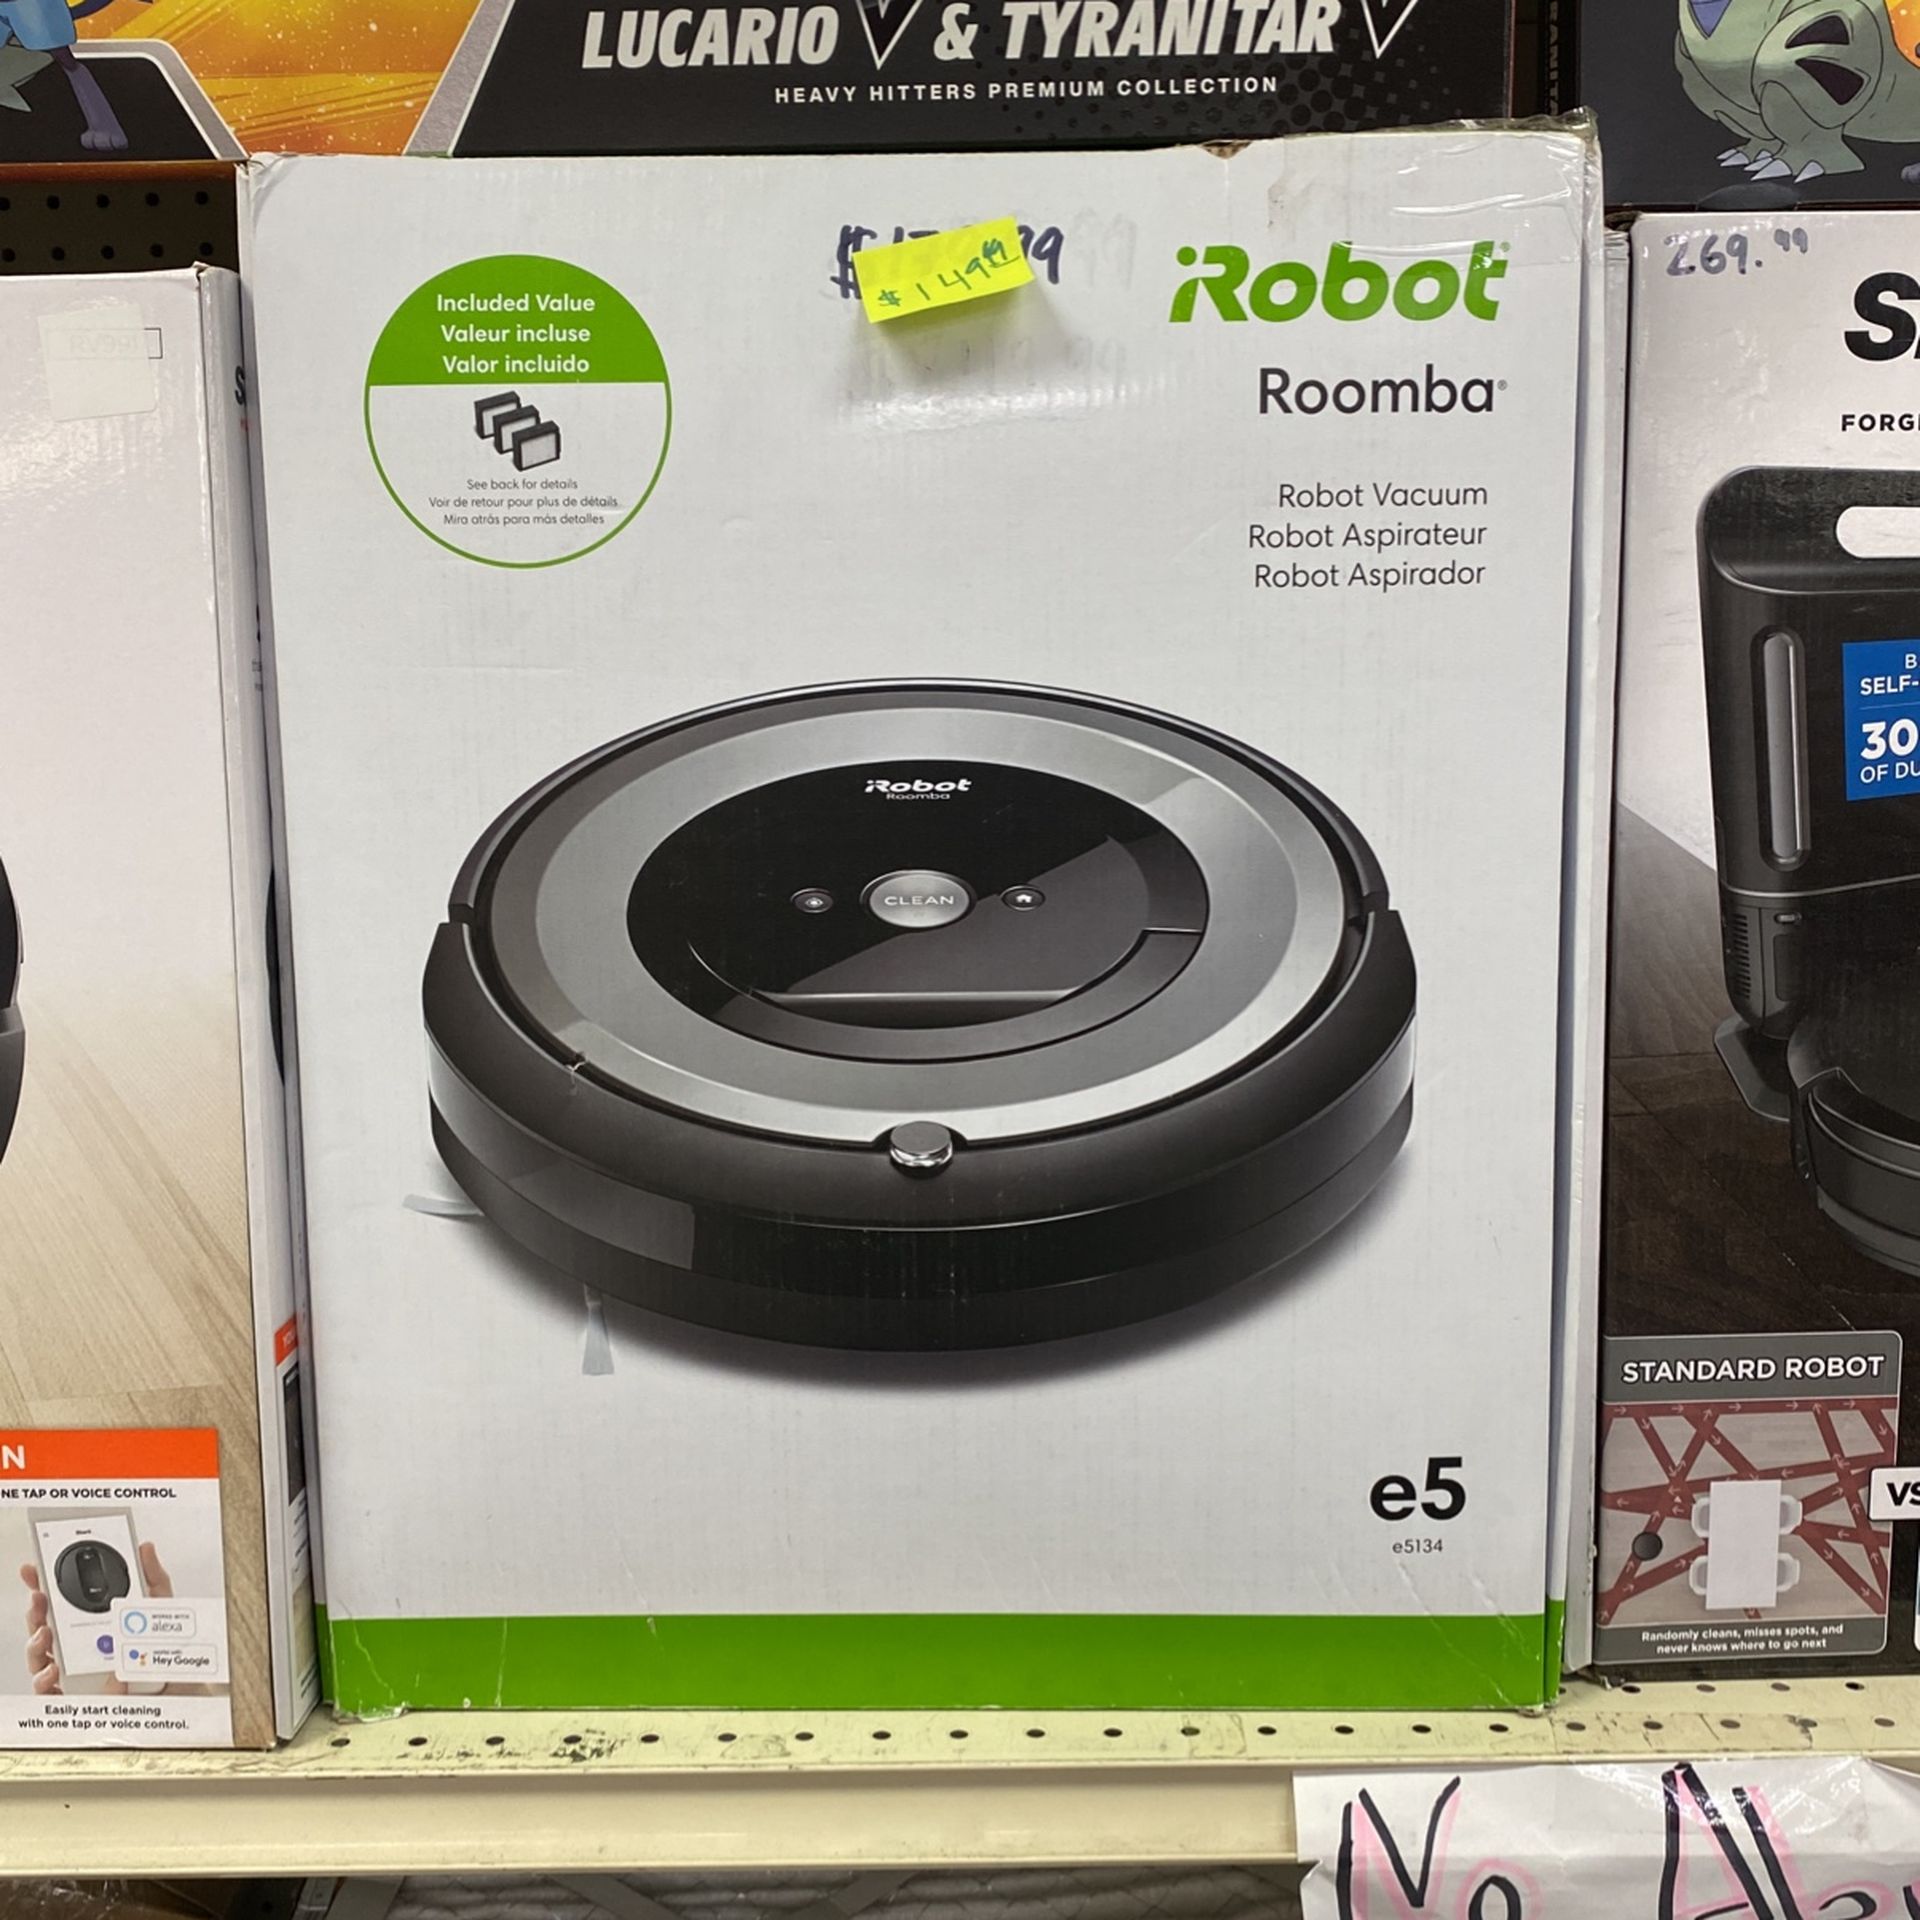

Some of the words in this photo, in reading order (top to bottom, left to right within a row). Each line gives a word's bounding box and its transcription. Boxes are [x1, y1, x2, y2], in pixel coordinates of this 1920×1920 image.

[582, 4, 839, 69] LUCARIO
[933, 3, 980, 61] &
[1003, 0, 1342, 59] TYRANITAR
[775, 86, 860, 104] HEAVY
[868, 83, 977, 103] HITTERS
[988, 80, 1105, 100] PREMIUM
[1117, 76, 1278, 97] COLLECTION
[437, 293, 529, 312] Included
[535, 293, 596, 312] Value
[1844, 271, 1920, 361] S
[441, 325, 510, 343] Valeur
[516, 323, 591, 342] incluse
[442, 355, 498, 373] Valor
[504, 354, 590, 373] incluido
[1841, 413, 1920, 432] FORG
[467, 479, 488, 490] See
[490, 478, 519, 490] back
[521, 478, 538, 490] for
[540, 478, 578, 490] details
[428, 496, 451, 507] Voir
[453, 496, 469, 507] de
[471, 497, 504, 508] retour
[507, 499, 533, 511] pour
[536, 496, 560, 510] plus
[562, 496, 578, 507] de
[1279, 482, 1364, 508] Robot
[1372, 482, 1488, 507] Vacuum
[444, 514, 468, 525] Mira
[471, 513, 500, 526] atrás
[503, 515, 531, 528] para
[533, 513, 557, 526] más
[560, 513, 605, 525] detalles
[1249, 522, 1334, 549] Robot
[1342, 521, 1488, 554] Aspirateur
[1255, 562, 1340, 588] Robot
[1347, 560, 1487, 593] Aspirador
[1860, 764, 1889, 783] OF
[865, 778, 972, 793] iRobot
[886, 792, 951, 800] Roomba
[884, 894, 954, 906] CLEAN
[1622, 1358, 1776, 1383] STANDARD
[1785, 1356, 1885, 1379] ROBOT
[1, 1444, 26, 1469] N
[22, 1488, 47, 1498] TAP
[49, 1488, 69, 1498] OR
[71, 1488, 111, 1498] VOICE
[114, 1488, 177, 1498] CONTROL
[1370, 1456, 1466, 1521] e5
[1392, 1538, 1443, 1554] e5134
[152, 1620, 183, 1632] alexa
[1641, 1628, 1699, 1643] Randomly
[1702, 1626, 1741, 1639] cleans,
[1744, 1626, 1782, 1637] misses
[1784, 1625, 1819, 1638] spots,
[1821, 1623, 1844, 1635] and
[1656, 1644, 1689, 1655] never
[1691, 1641, 1728, 1653] knows
[1731, 1640, 1766, 1651] where
[1768, 1639, 1781, 1650] to
[1783, 1640, 1799, 1652] go
[1801, 1638, 1827, 1649] next
[152, 1655, 172, 1666] Hey
[173, 1655, 210, 1667] Google
[44, 1704, 79, 1716] Easily
[82, 1704, 109, 1715] start
[111, 1704, 162, 1717] cleaning
[18, 1718, 43, 1729] with
[47, 1720, 69, 1729] one
[72, 1719, 91, 1730] tap
[94, 1720, 107, 1729] or
[111, 1718, 141, 1729] voice
[144, 1718, 190, 1730] control.
